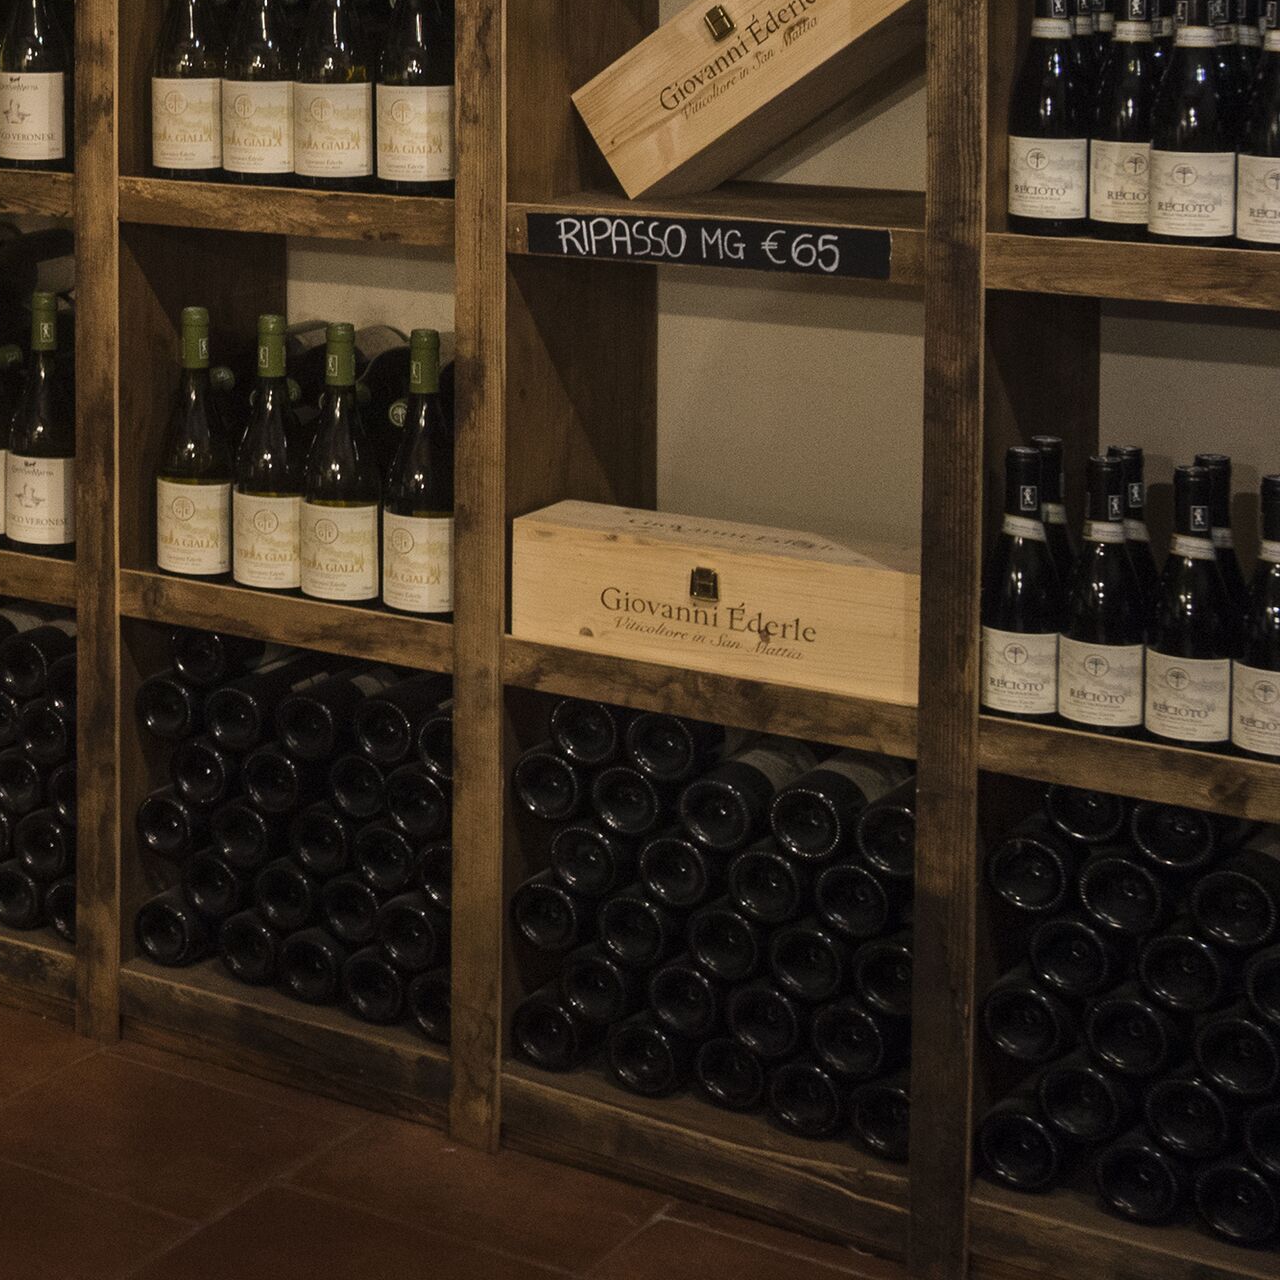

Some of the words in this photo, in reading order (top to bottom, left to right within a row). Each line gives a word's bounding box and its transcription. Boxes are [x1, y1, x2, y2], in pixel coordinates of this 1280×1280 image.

[658, 35, 752, 113] Giovanni
[1014, 184, 1067, 196] RECIOTO
[1157, 201, 1216, 213] RECIOTO
[555, 217, 687, 258] RIPASSO
[701, 227, 747, 260] MG
[600, 586, 719, 629] Giovanni
